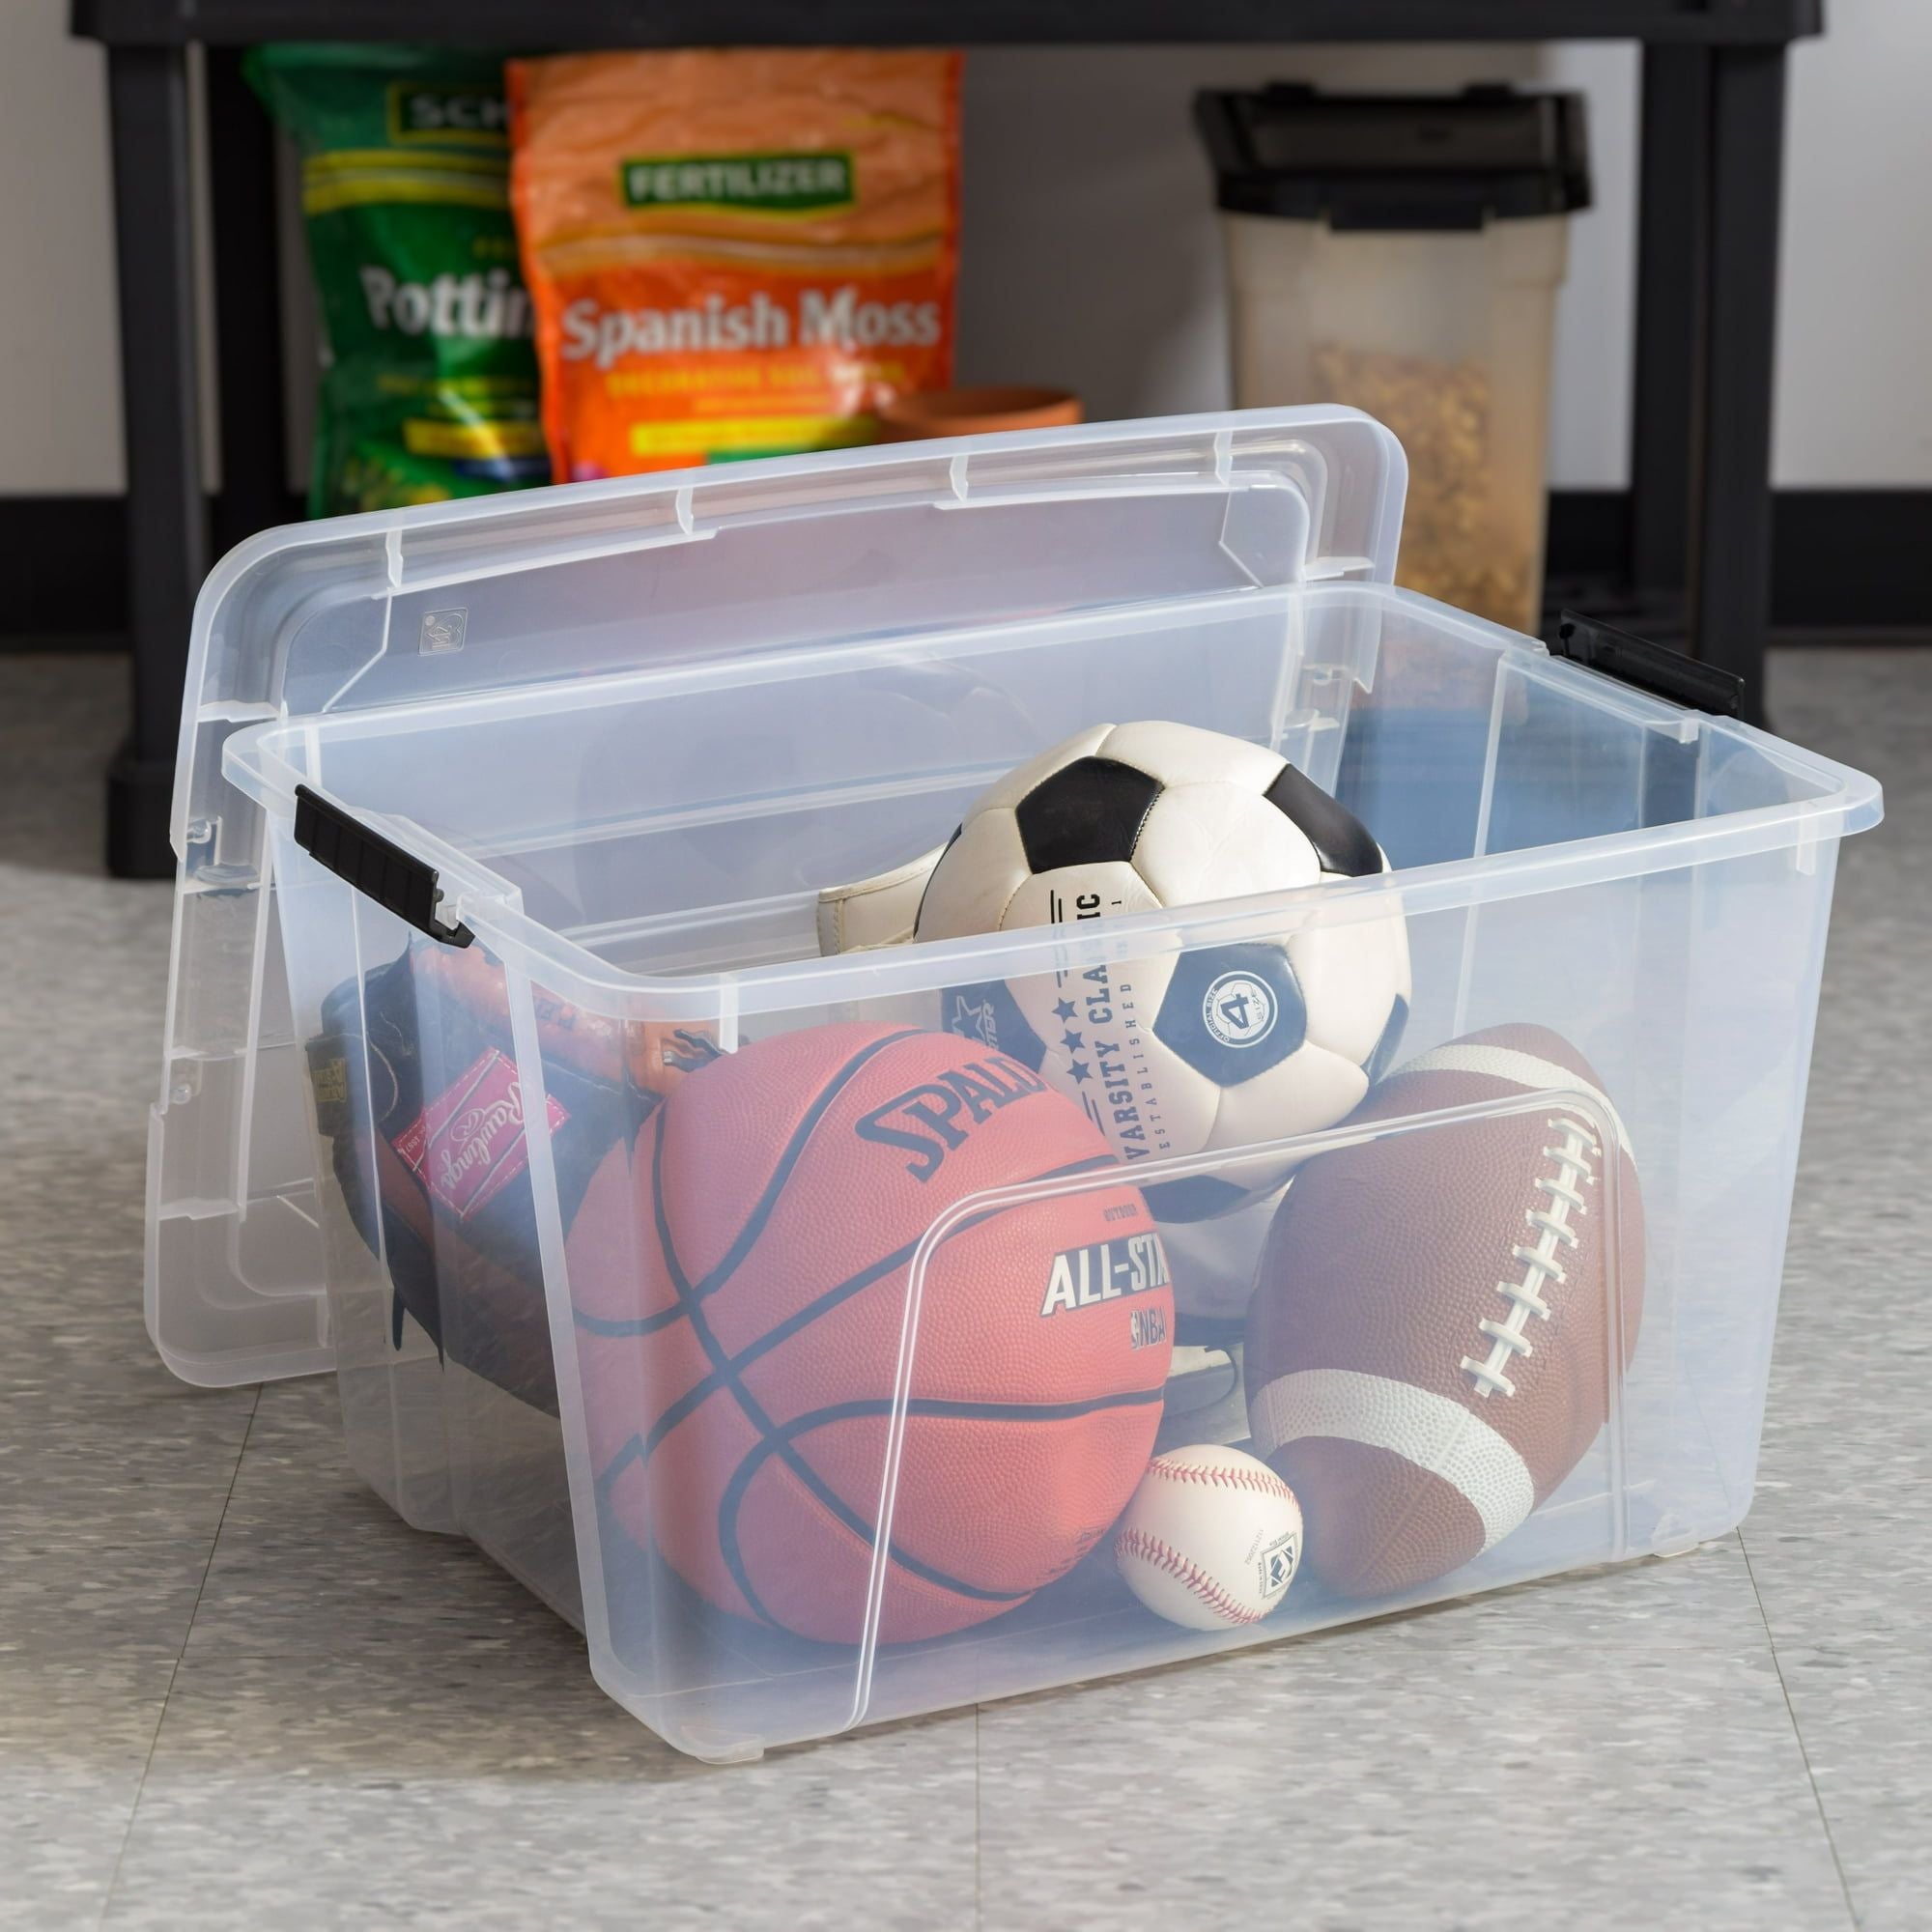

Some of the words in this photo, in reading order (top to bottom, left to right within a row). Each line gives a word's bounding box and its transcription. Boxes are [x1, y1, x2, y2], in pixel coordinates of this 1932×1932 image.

[629, 157, 848, 203] FERTILIZER
[561, 291, 790, 369] Spanish
[798, 288, 942, 349] Moss
[1220, 993, 1250, 1030] 4
[1120, 983, 1171, 1151] ESTABLISHED
[1094, 1038, 1151, 1160] VARSITY
[1139, 1306, 1167, 1347] NBA
